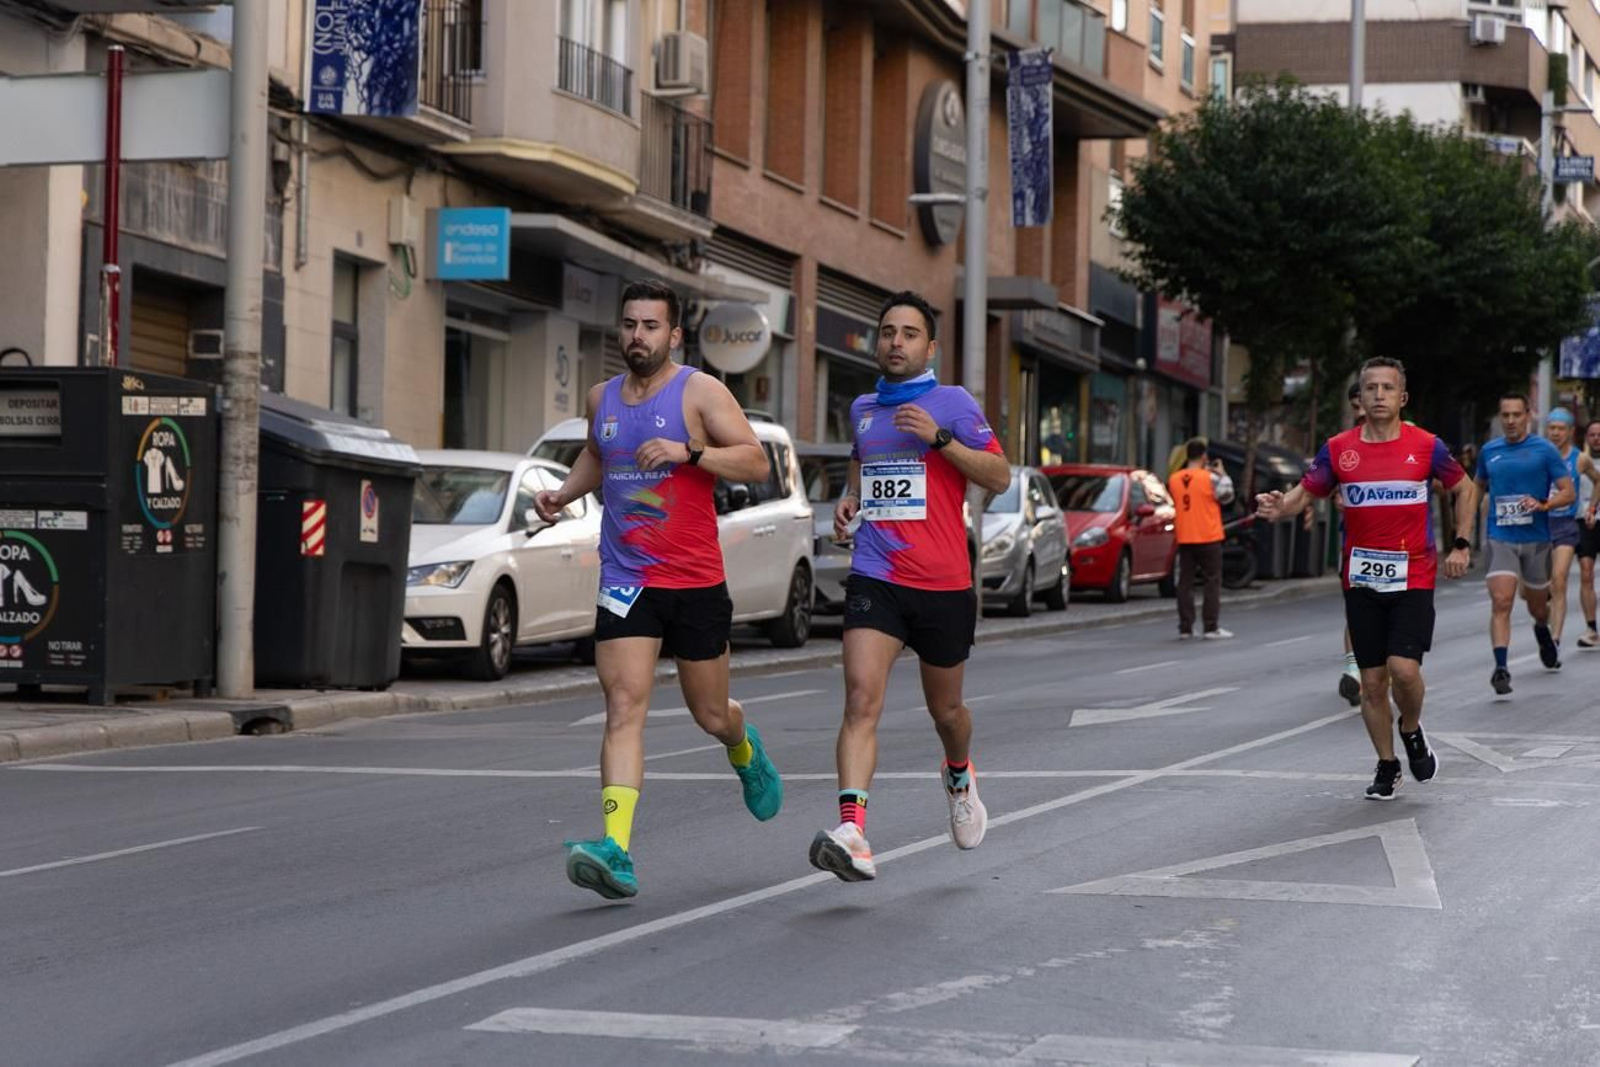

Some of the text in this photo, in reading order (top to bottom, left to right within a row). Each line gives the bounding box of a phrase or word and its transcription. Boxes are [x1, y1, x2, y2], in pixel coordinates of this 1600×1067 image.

[333, 13, 348, 54] JUAN
[445, 224, 498, 237] endesa
[722, 327, 762, 345] Jucar
[152, 431, 176, 447] ROPA
[644, 470, 674, 480] REAL
[872, 479, 912, 499] 882
[1366, 488, 1418, 501] Avanza
[152, 497, 182, 509] CALZADO
[1182, 493, 1191, 512] 9
[1360, 561, 1397, 578] 296
[48, 641, 82, 651] NO TIRAR
